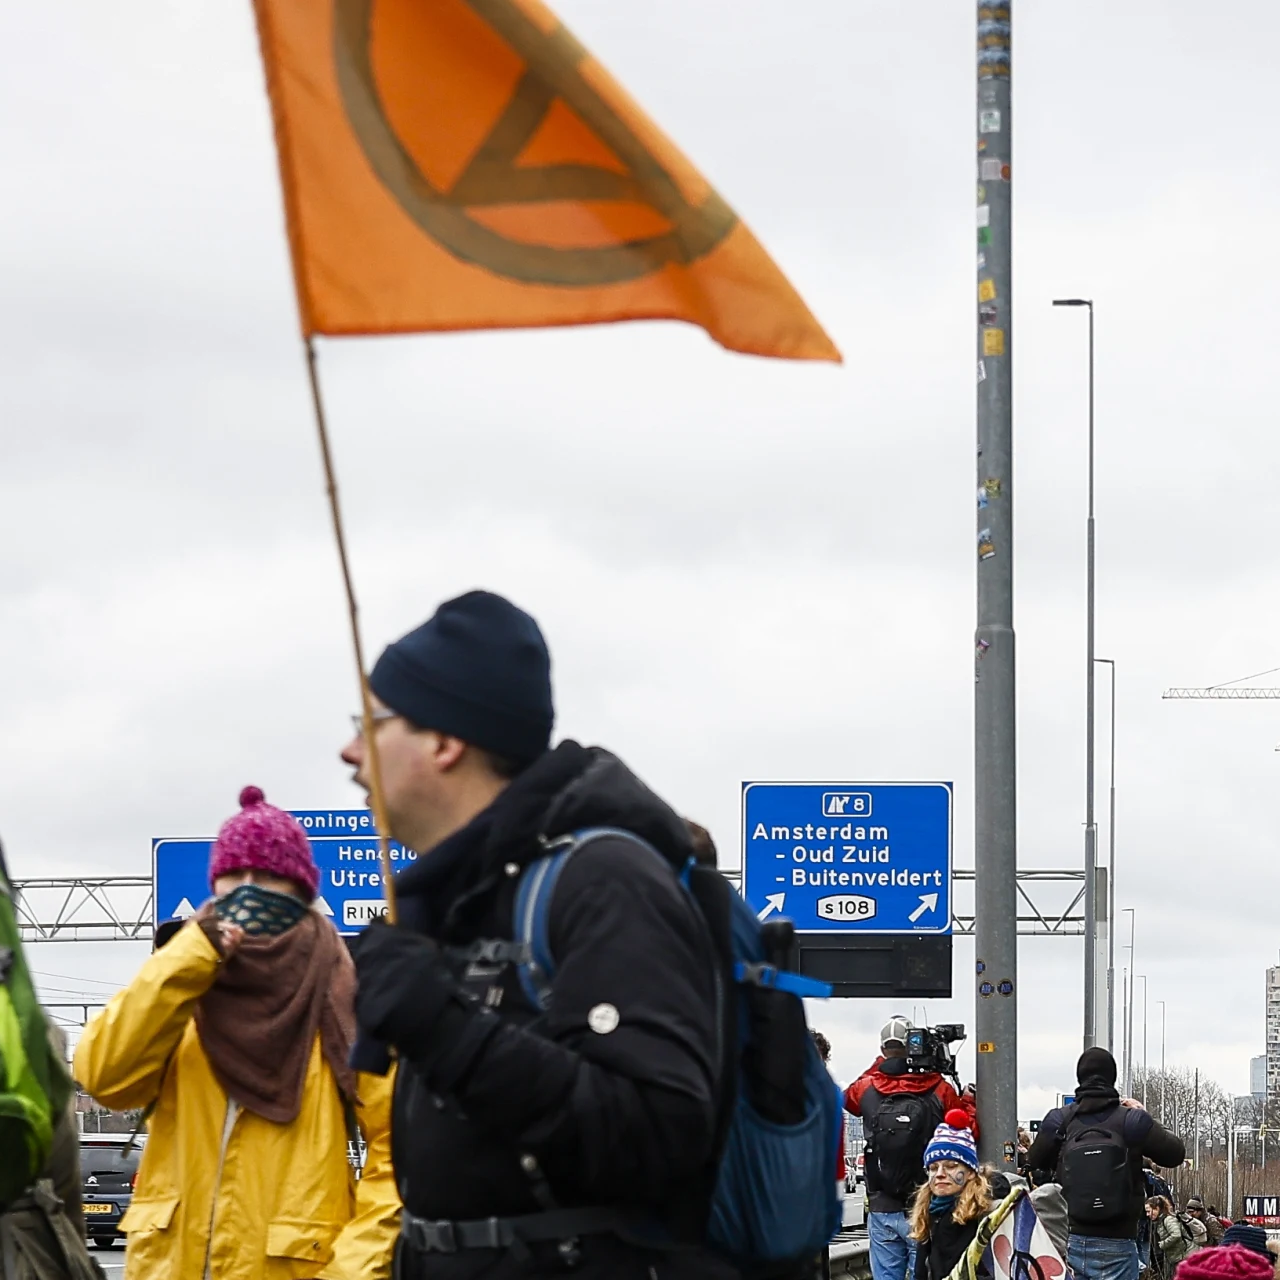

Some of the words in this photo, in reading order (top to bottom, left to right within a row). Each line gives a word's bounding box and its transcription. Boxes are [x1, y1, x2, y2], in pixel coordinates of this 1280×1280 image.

[853, 797, 865, 812] 8
[296, 813, 375, 832] roninge
[752, 822, 889, 841] Amsterdam
[792, 845, 834, 863] Oud
[841, 845, 890, 863] Zuid
[330, 869, 401, 887] Utre
[791, 868, 942, 887] Buitenveldert
